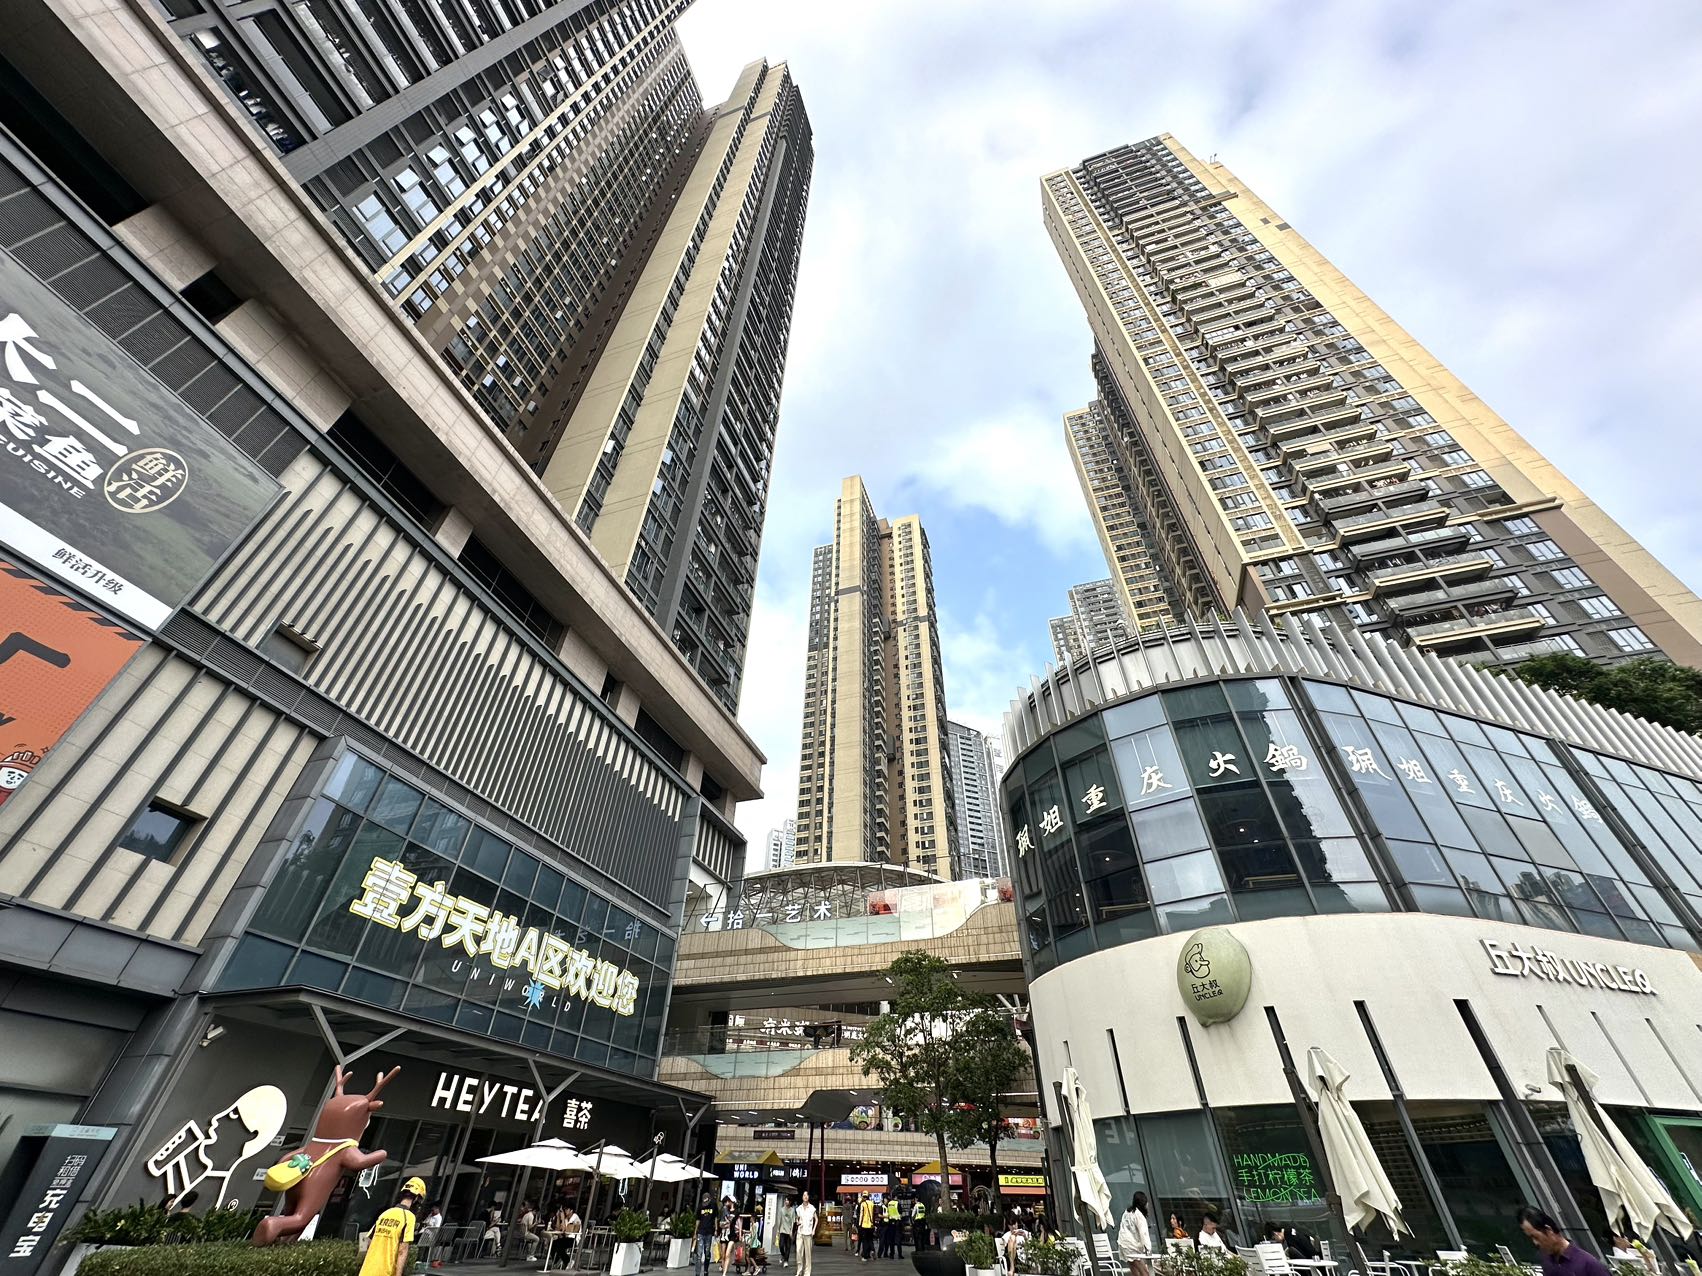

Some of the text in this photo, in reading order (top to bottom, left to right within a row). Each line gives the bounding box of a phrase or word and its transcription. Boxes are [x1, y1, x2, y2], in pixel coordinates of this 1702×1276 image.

[51, 547, 124, 596] 鲜活升级
[727, 901, 832, 930] 拾一艺术
[349, 856, 640, 1017] 壹方天地A区欢迎您
[1191, 979, 1220, 994] 丘大叔
[431, 1072, 593, 1130] HEYTEA 喜茶
[64, 1154, 87, 1166] 扫码
[734, 1163, 748, 1171] UNI
[733, 1170, 759, 1179] WORLD
[1238, 1168, 1315, 1185] 手打柠檬茶
[1243, 1187, 1292, 1202] LEMON
[8, 1188, 68, 1258] 充电宝
